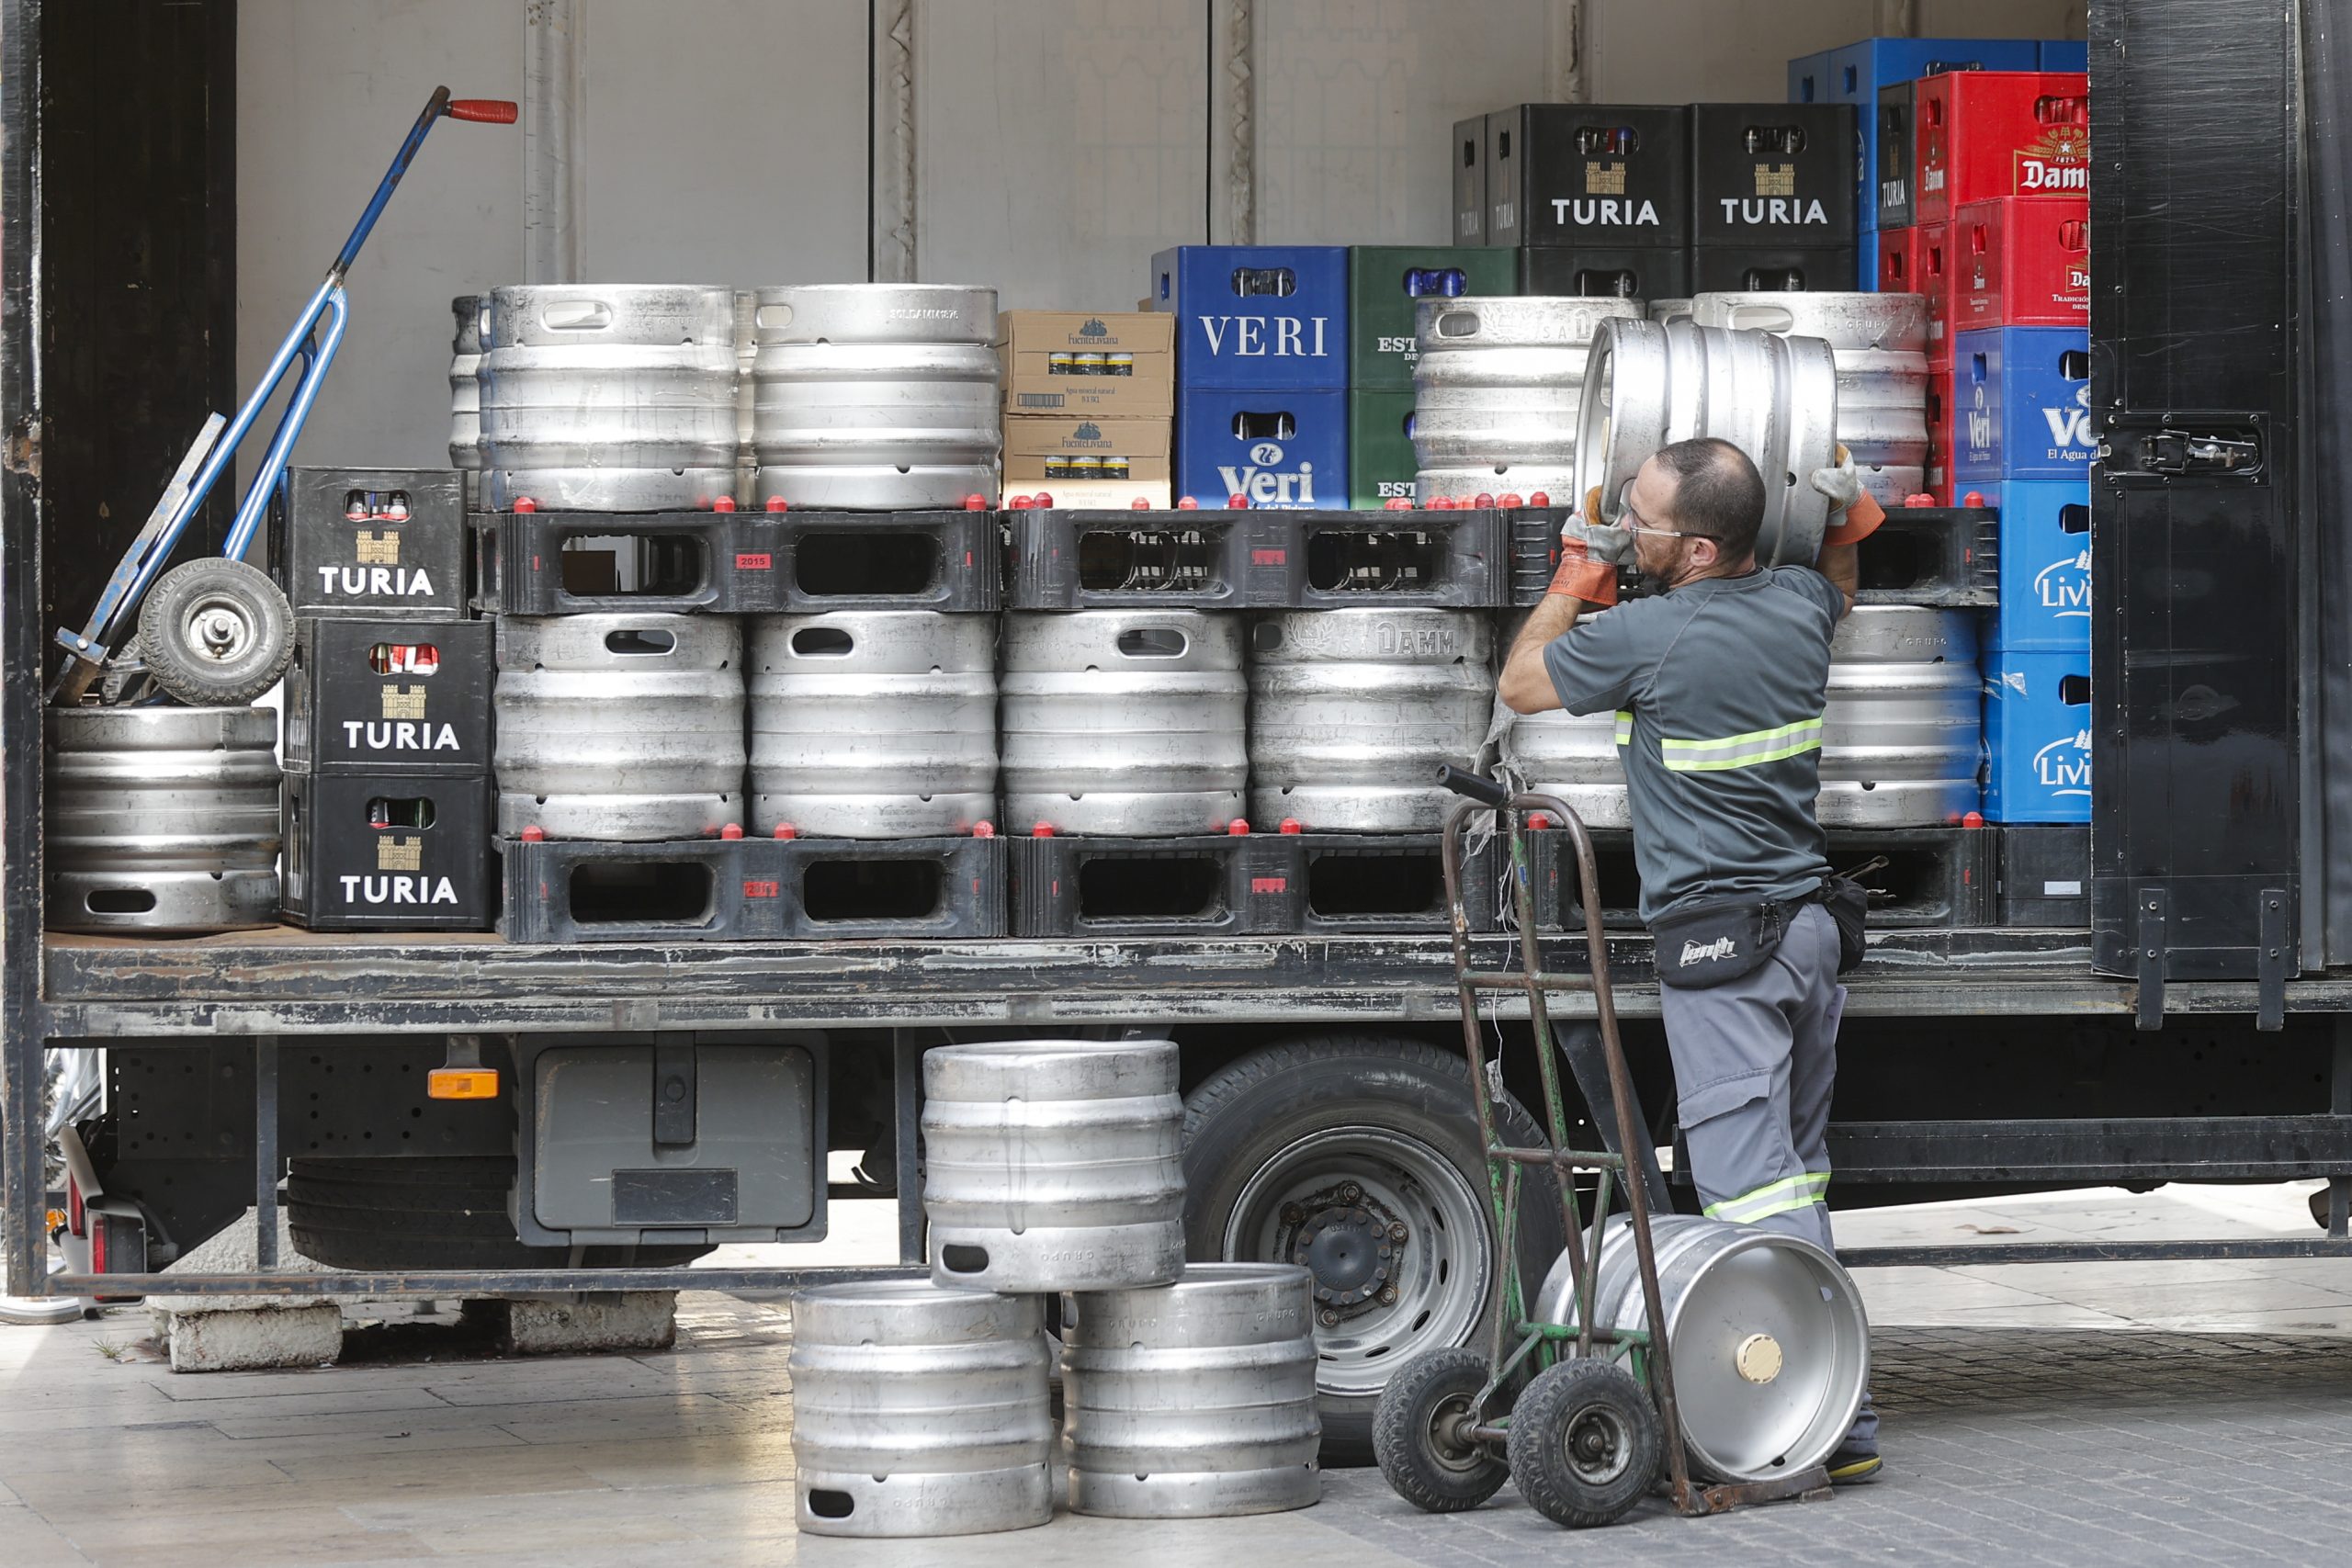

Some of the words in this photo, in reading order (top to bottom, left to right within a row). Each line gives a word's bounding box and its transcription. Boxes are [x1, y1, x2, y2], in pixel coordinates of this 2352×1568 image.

[2020, 161, 2089, 188] Dam
[1883, 179, 1905, 208] TURIA
[1496, 202, 1514, 231] TURIA
[1552, 199, 1659, 225] TURIA
[1721, 198, 1827, 224] TURIA
[1198, 316, 1329, 356] VERI
[1377, 337, 1417, 352] EST
[1968, 405, 1991, 449] Veri
[2048, 448, 2057, 459] El
[2061, 449, 2087, 462] Agua
[1217, 461, 1316, 503] Veri
[1377, 482, 1416, 497] EST
[741, 558, 765, 566] 2015
[318, 566, 435, 596] TURIA
[1377, 621, 1454, 655] DAMM
[1905, 637, 1948, 647] GRUPO
[343, 721, 460, 750] TURIA
[340, 875, 458, 904] TURIA
[1041, 1250, 1094, 1262] GRUPO
[1256, 1308, 1295, 1323] GRUPO
